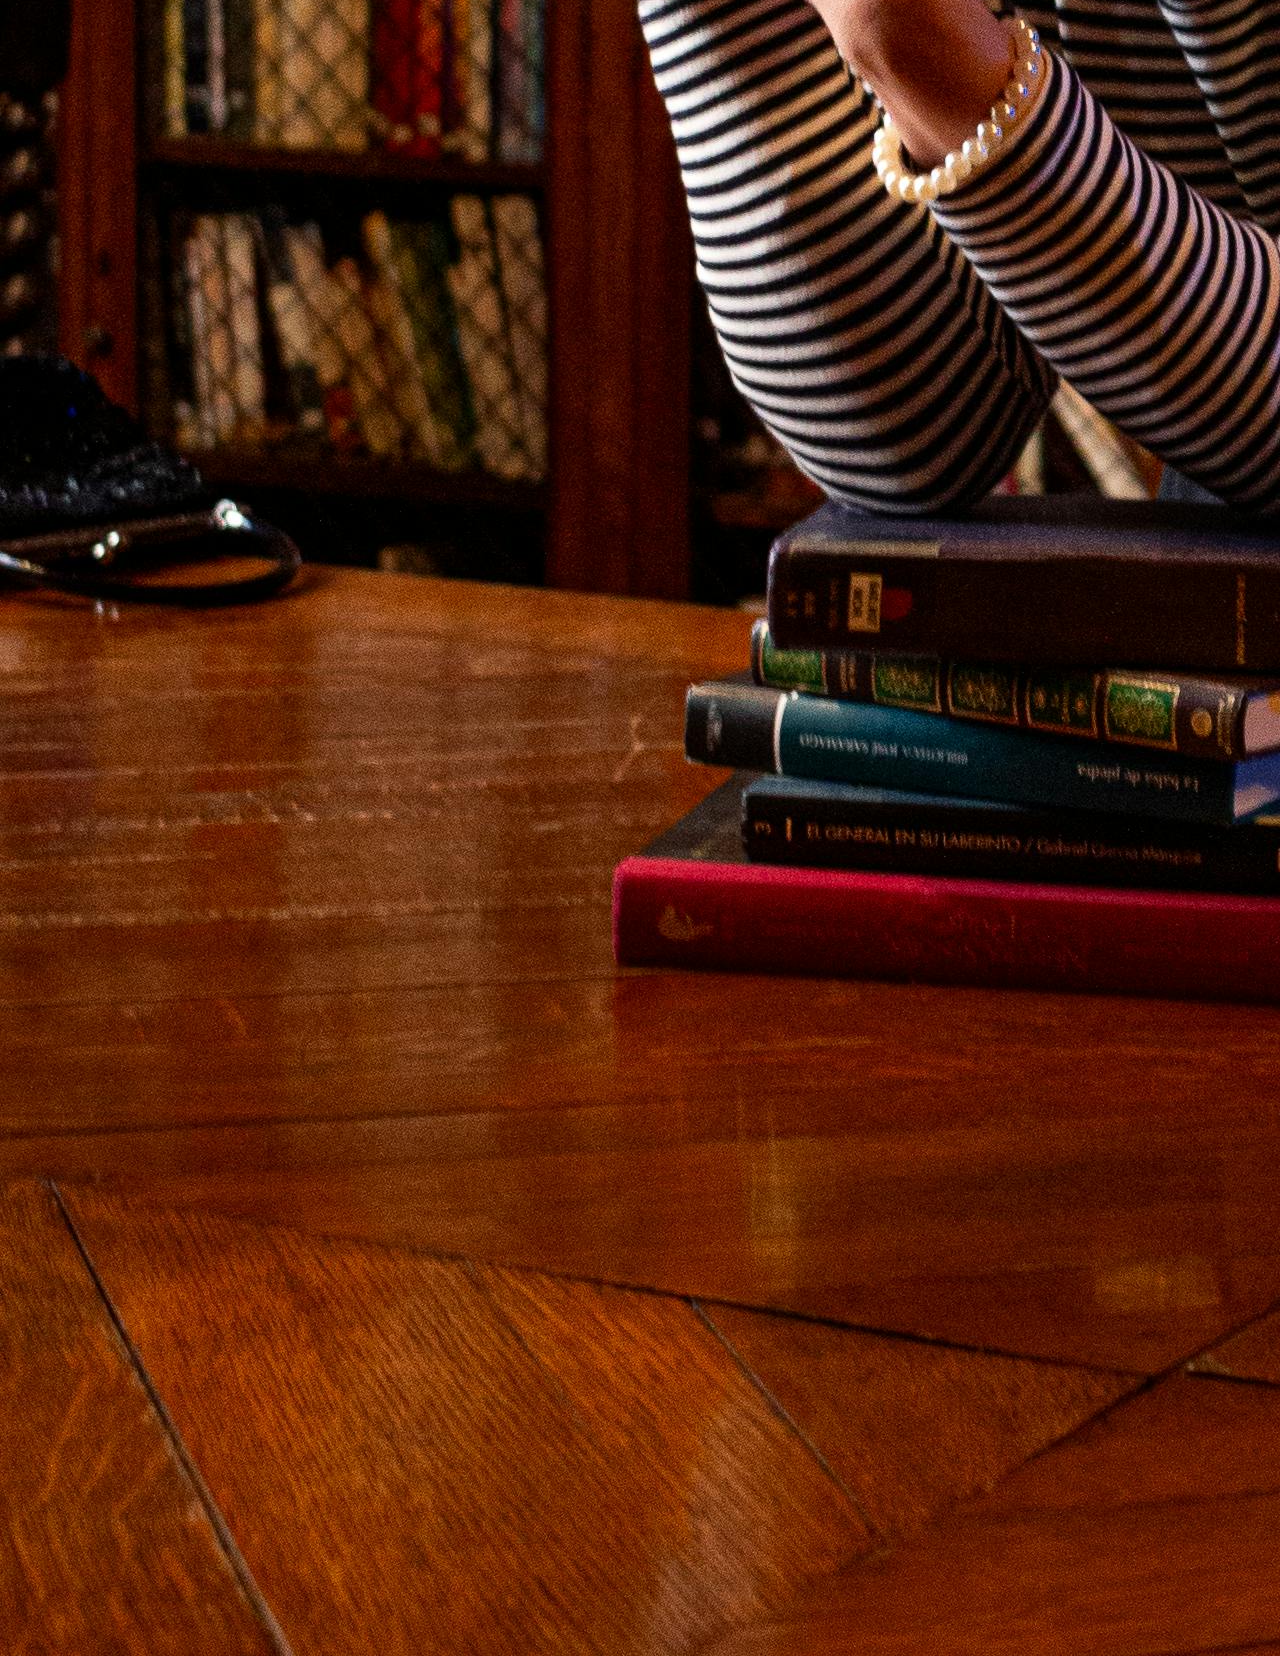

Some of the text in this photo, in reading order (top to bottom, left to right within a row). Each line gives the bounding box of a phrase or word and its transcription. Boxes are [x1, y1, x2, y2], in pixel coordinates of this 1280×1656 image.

[799, 733, 869, 755] SARAMAGO
[1077, 762, 1121, 783] piedra
[1124, 768, 1142, 787] de
[1183, 776, 1200, 793] La
[806, 822, 821, 841] EL
[825, 824, 892, 845] GENERAL
[895, 828, 916, 845] EN
[920, 831, 939, 848] SU
[944, 832, 1022, 853] LABERINTO
